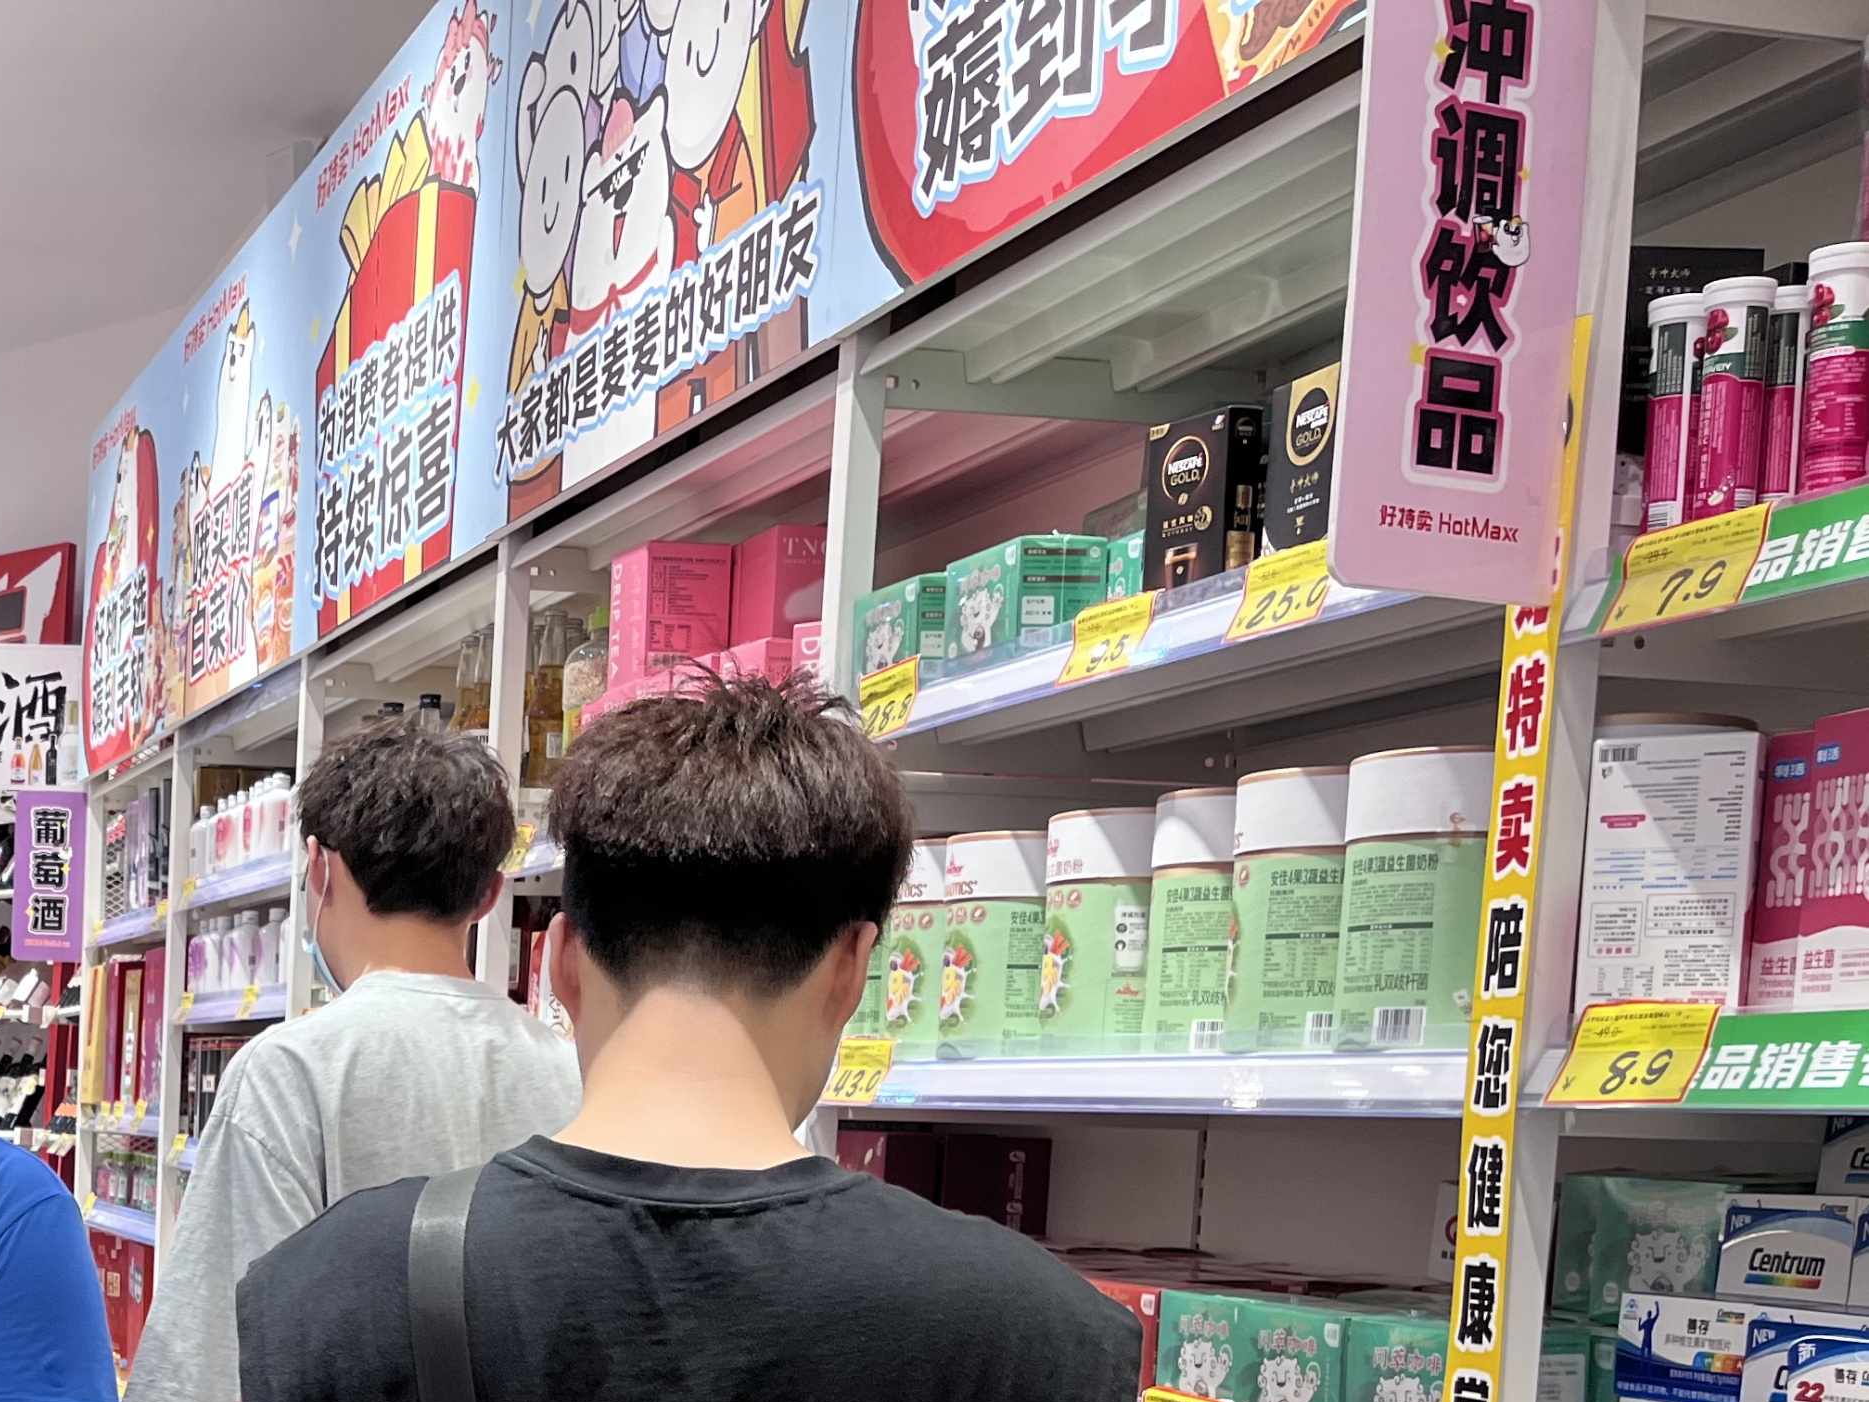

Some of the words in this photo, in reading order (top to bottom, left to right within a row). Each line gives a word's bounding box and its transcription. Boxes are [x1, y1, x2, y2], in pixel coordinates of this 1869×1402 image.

[1417, 0, 1531, 476] 冲调饮品
[495, 188, 821, 477] 大家都是麦麦的好朋友
[320, 286, 458, 461] 为消费者提供
[313, 395, 453, 599] 持续惊喜
[1438, 513, 1519, 544] HotMaxx
[612, 564, 623, 627] DRIP
[1246, 574, 1329, 630] 25.0
[1657, 559, 1728, 617] 7.9
[30, 808, 70, 933] 葡萄酒
[1599, 1049, 1674, 1095] 8.9
[1749, 1248, 1825, 1277] Centrum
[1687, 1318, 1710, 1336] 善存
[1794, 1381, 1825, 1402] 22
